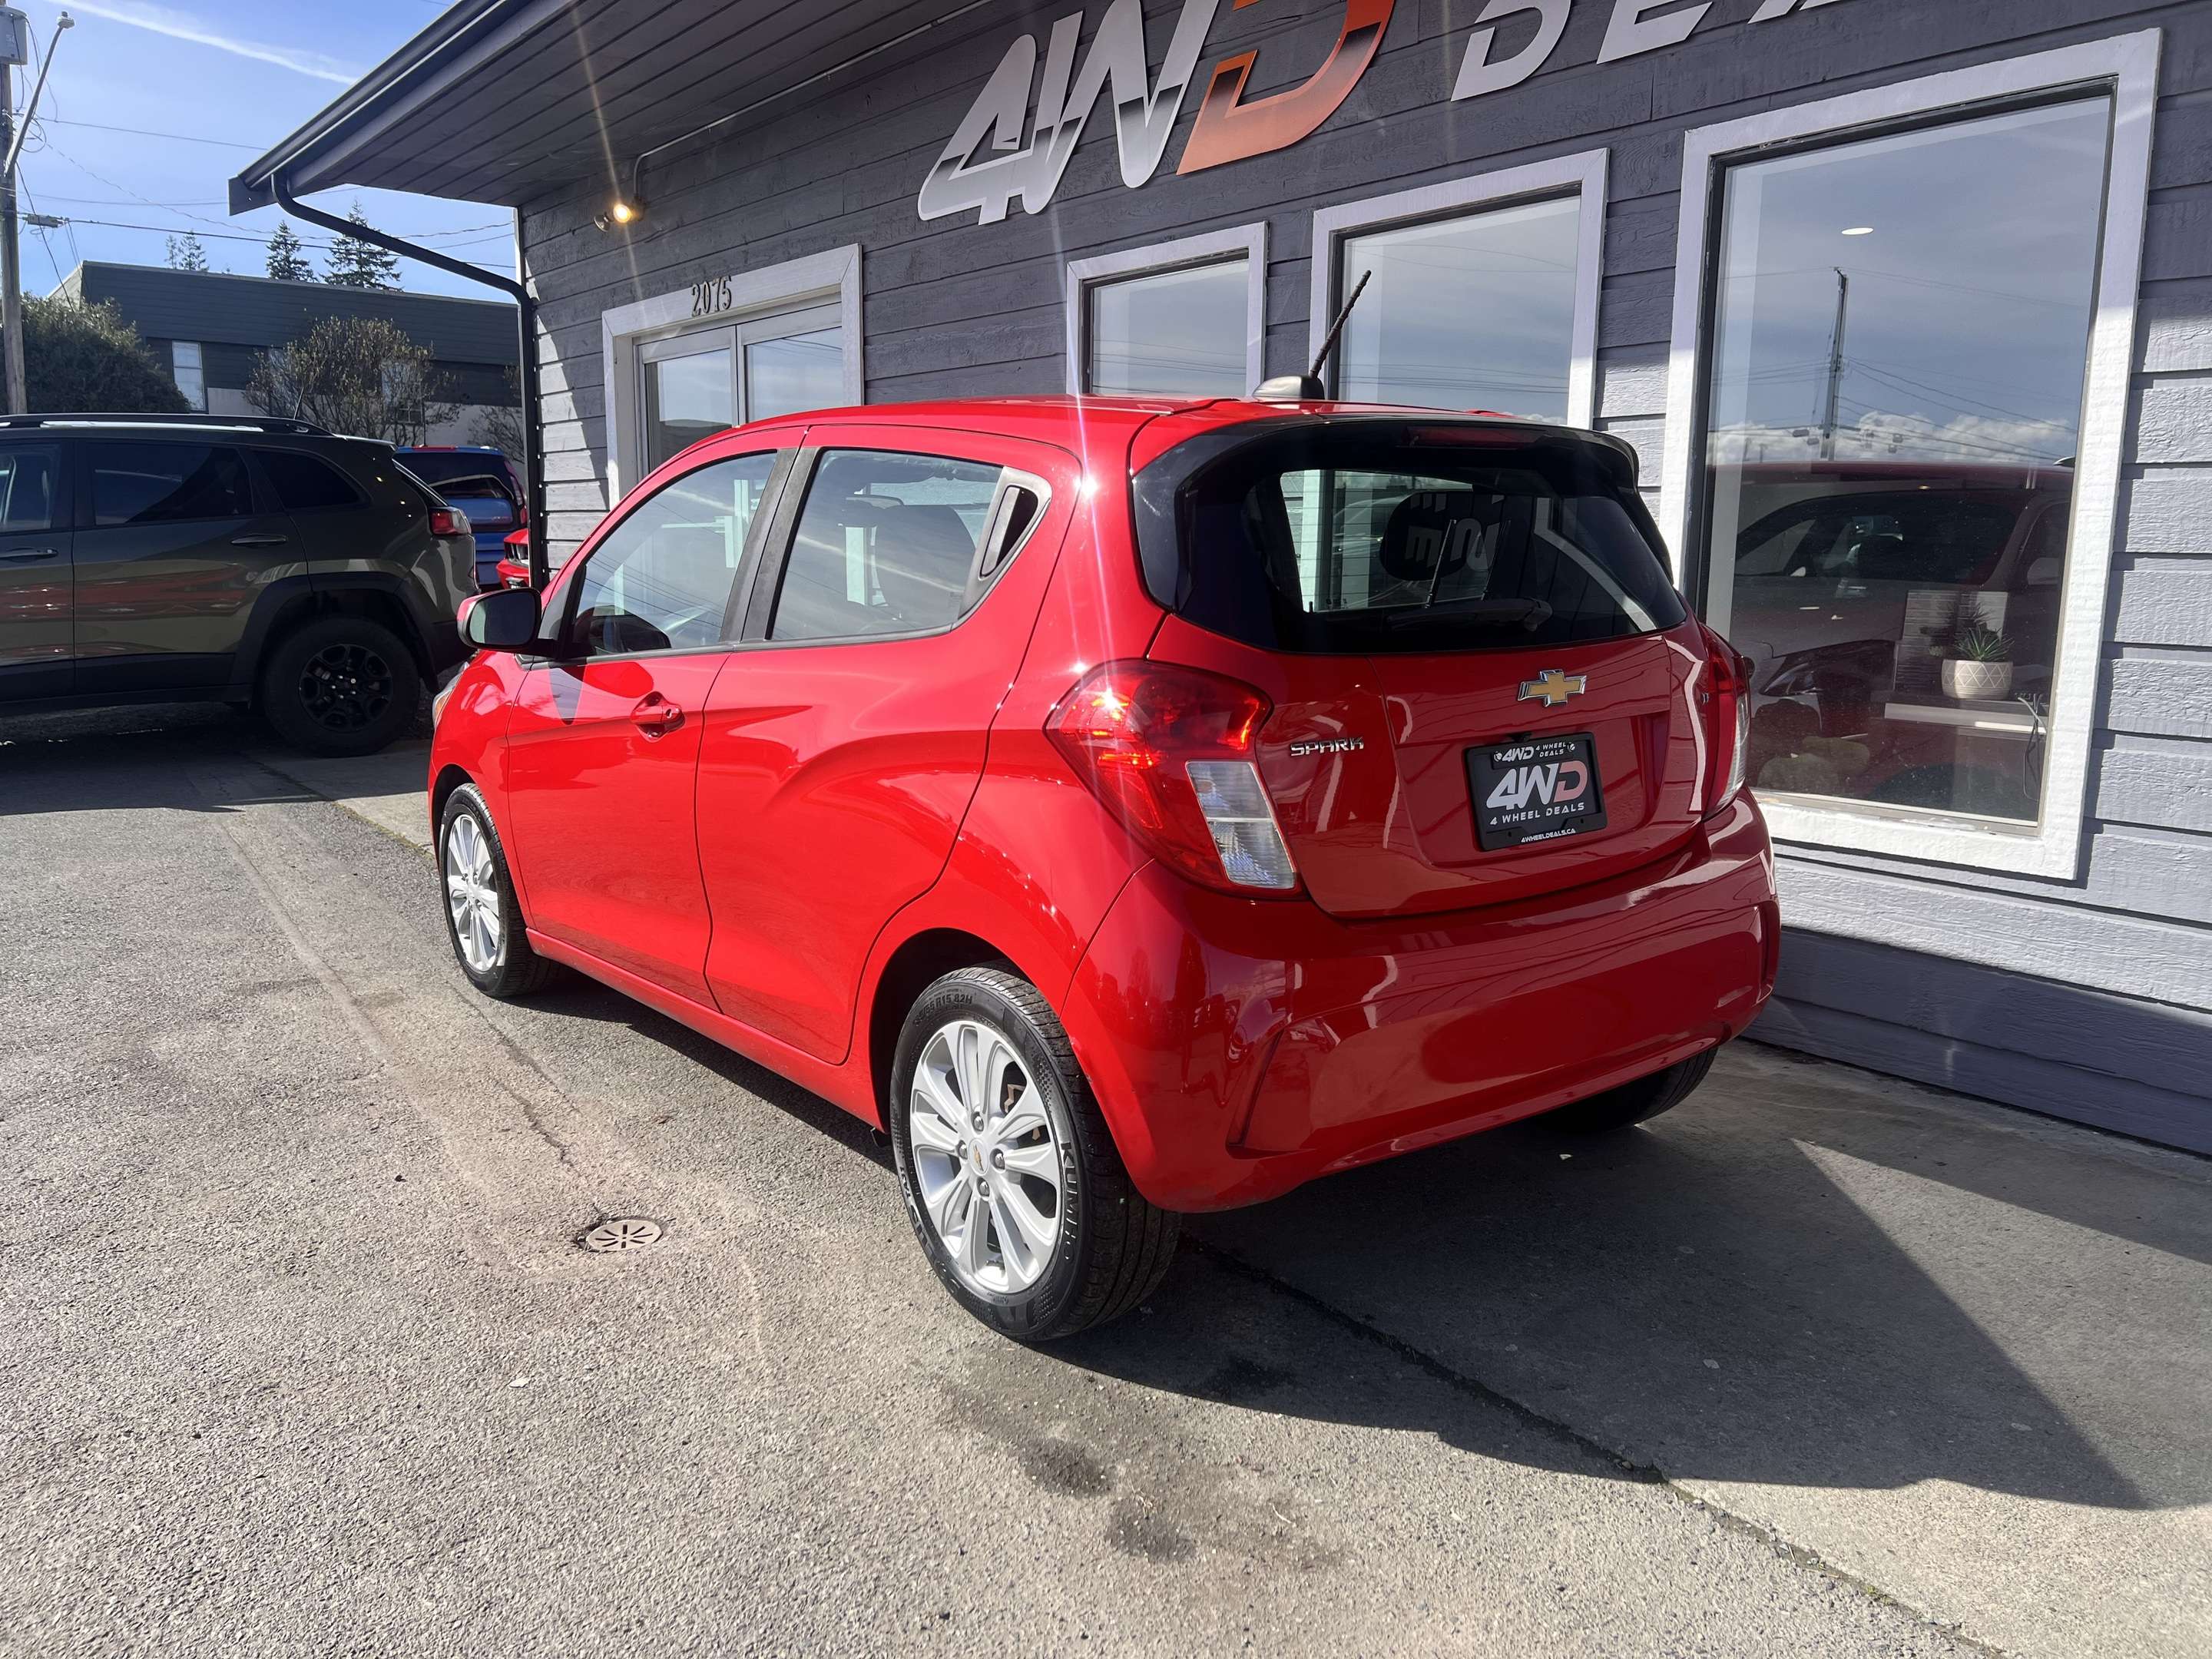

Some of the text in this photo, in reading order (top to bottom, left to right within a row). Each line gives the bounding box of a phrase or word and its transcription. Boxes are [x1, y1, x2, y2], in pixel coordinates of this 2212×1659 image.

[918, 0, 1395, 225] 4WD
[692, 275, 732, 316] 2075
[1290, 737, 1365, 757] SPARK
[1502, 746, 1534, 762] 4WD
[1539, 749, 1564, 757] DEALS
[1486, 760, 1588, 810] 4WD
[1489, 802, 1585, 826] 4 WHEEL DEALS
[1521, 829, 1576, 843] 4WHEELDEALS.CA
[1061, 1142, 1078, 1263] KUMHO
